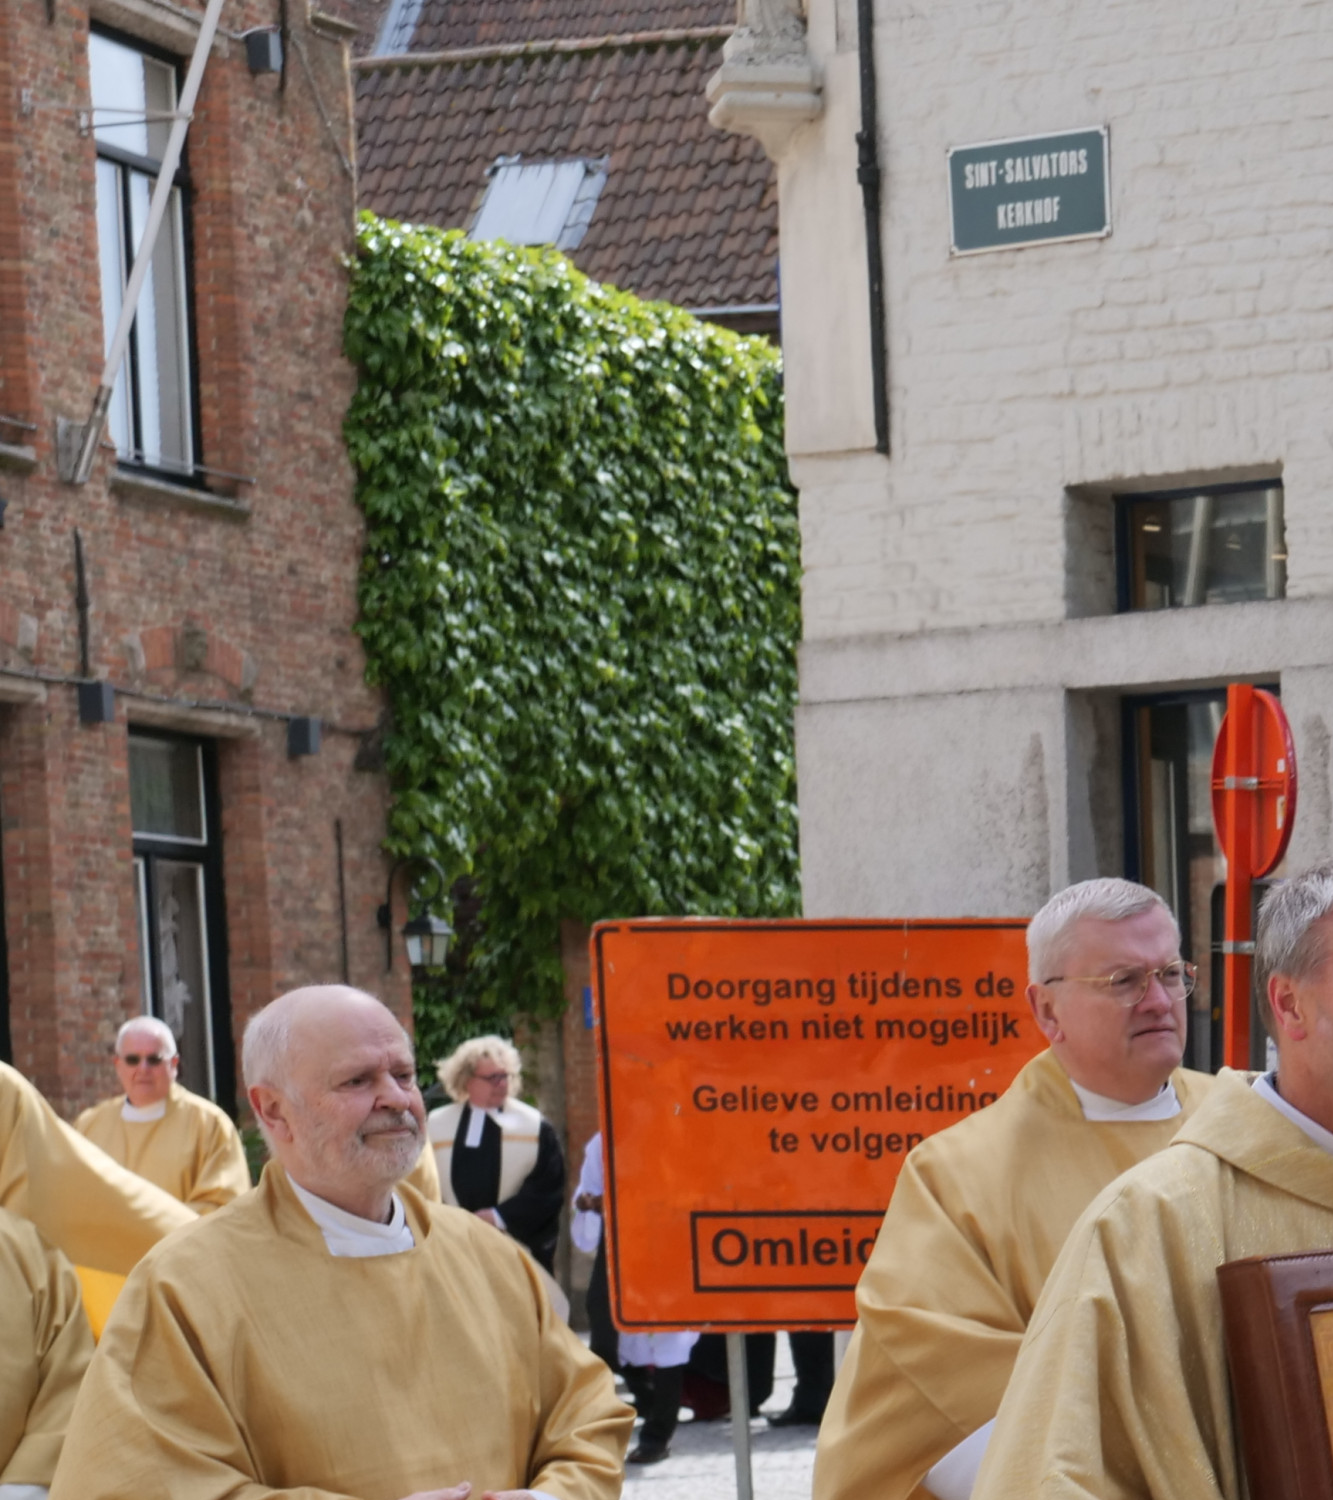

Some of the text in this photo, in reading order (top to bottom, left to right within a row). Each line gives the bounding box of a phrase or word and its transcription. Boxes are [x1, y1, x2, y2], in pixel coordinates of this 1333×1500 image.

[964, 148, 1088, 189] SINT-SALVATORS
[997, 196, 1060, 229] KERKHOF
[667, 971, 1015, 1007] Doorgang tijdens de
[665, 1011, 1020, 1047] werken niet mogelijk
[692, 1084, 819, 1113] Gelieve
[768, 1127, 799, 1153] te
